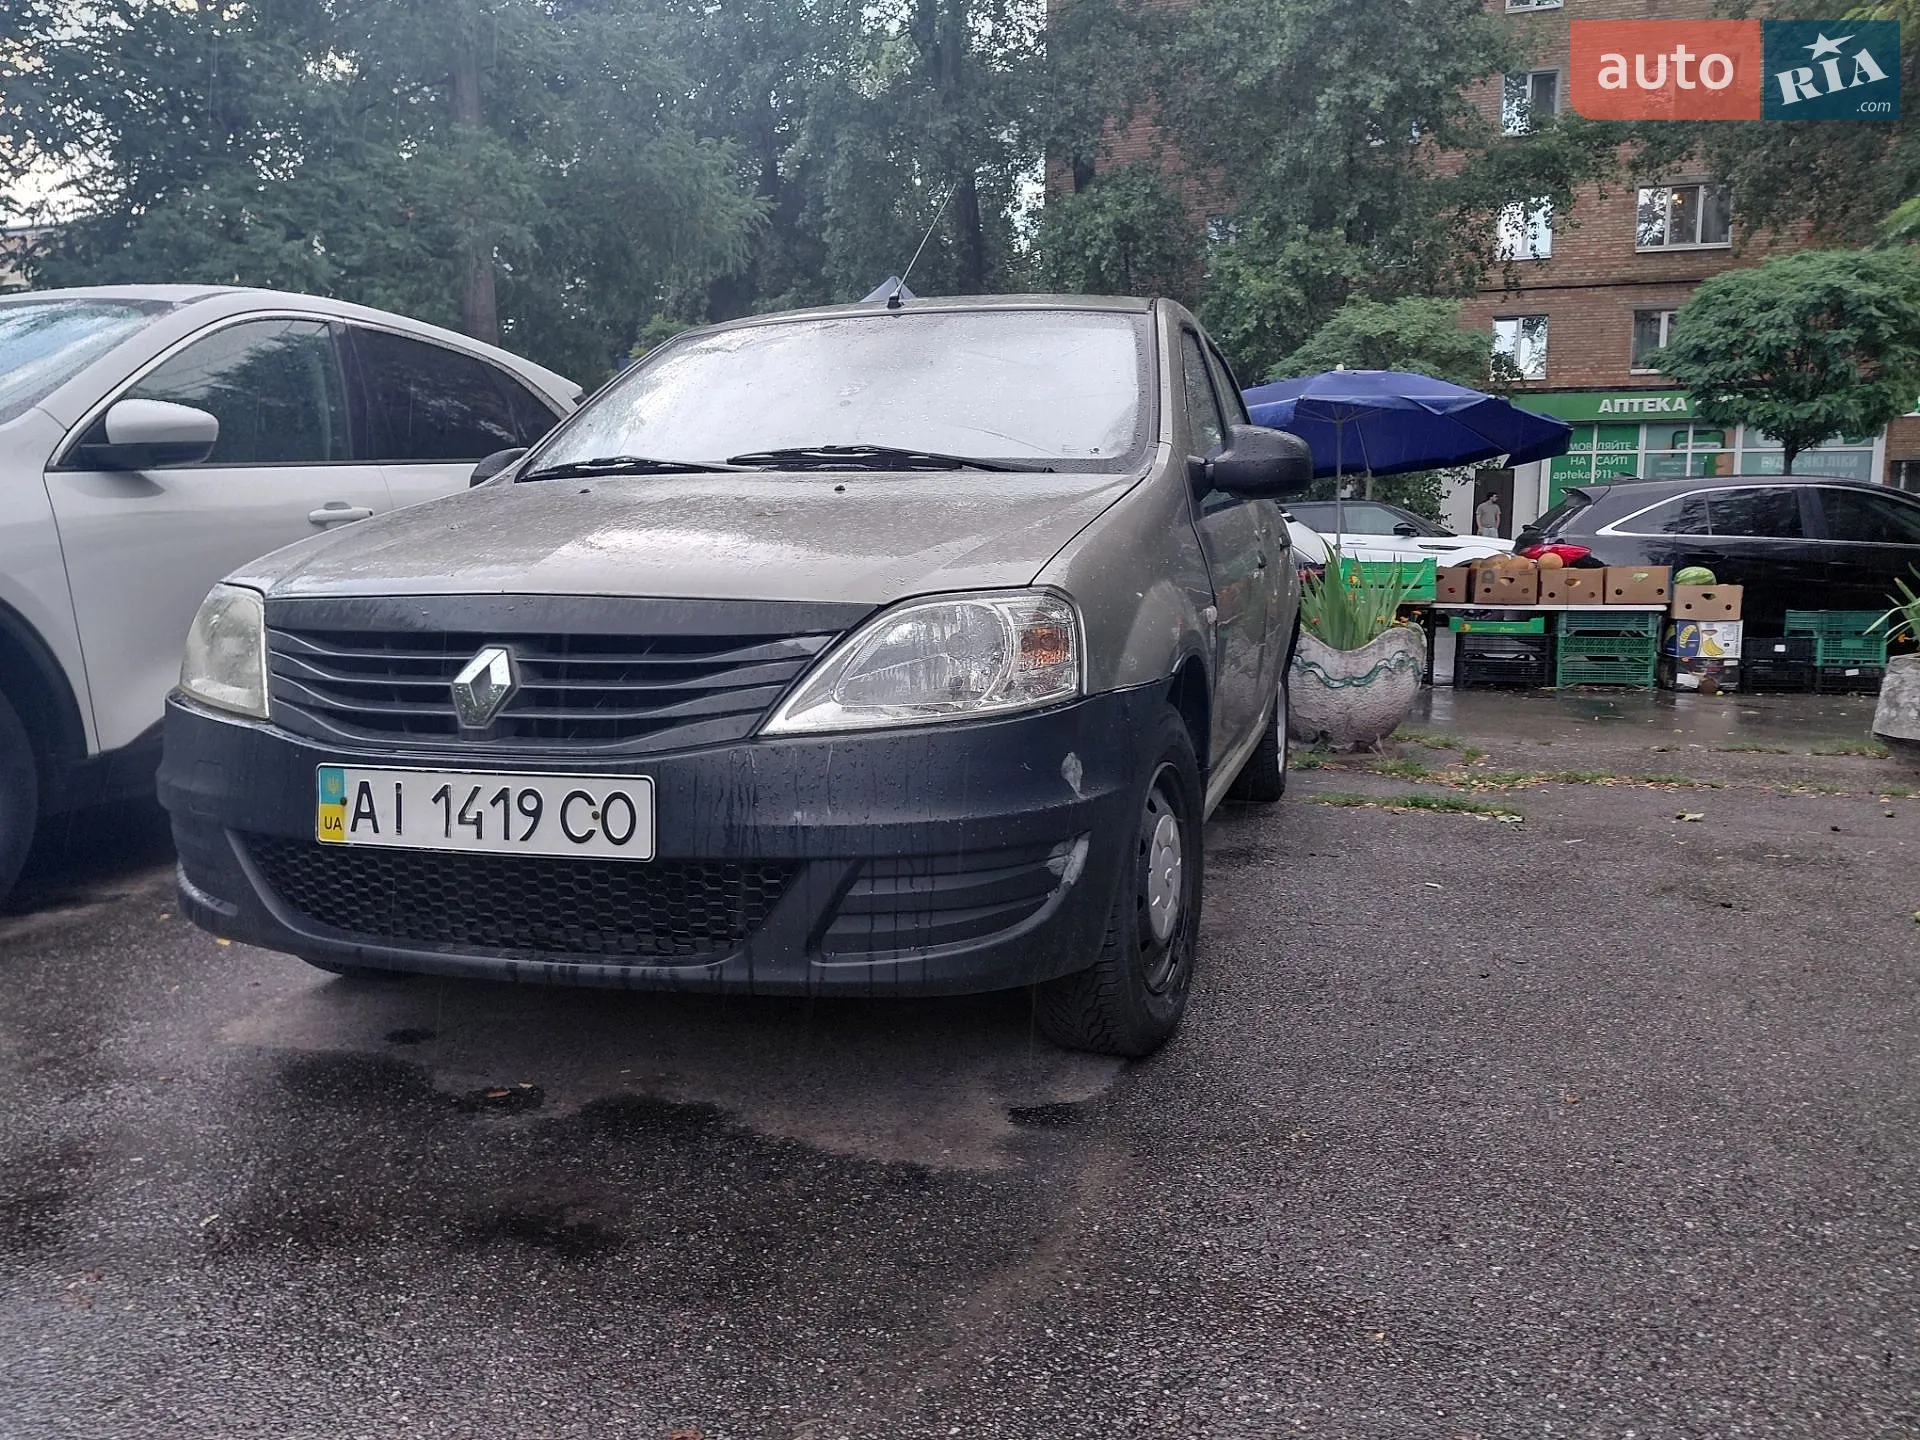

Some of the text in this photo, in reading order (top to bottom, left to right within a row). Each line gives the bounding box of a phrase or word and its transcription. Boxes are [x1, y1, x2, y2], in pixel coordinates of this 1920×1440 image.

[1597, 397, 1688, 413] АПТЕКА
[1569, 440, 1631, 451] МОВЛЯЙТЕ
[1570, 456, 1586, 465] НА
[350, 780, 637, 845] AI 1419 CO
[324, 815, 342, 831] UA
